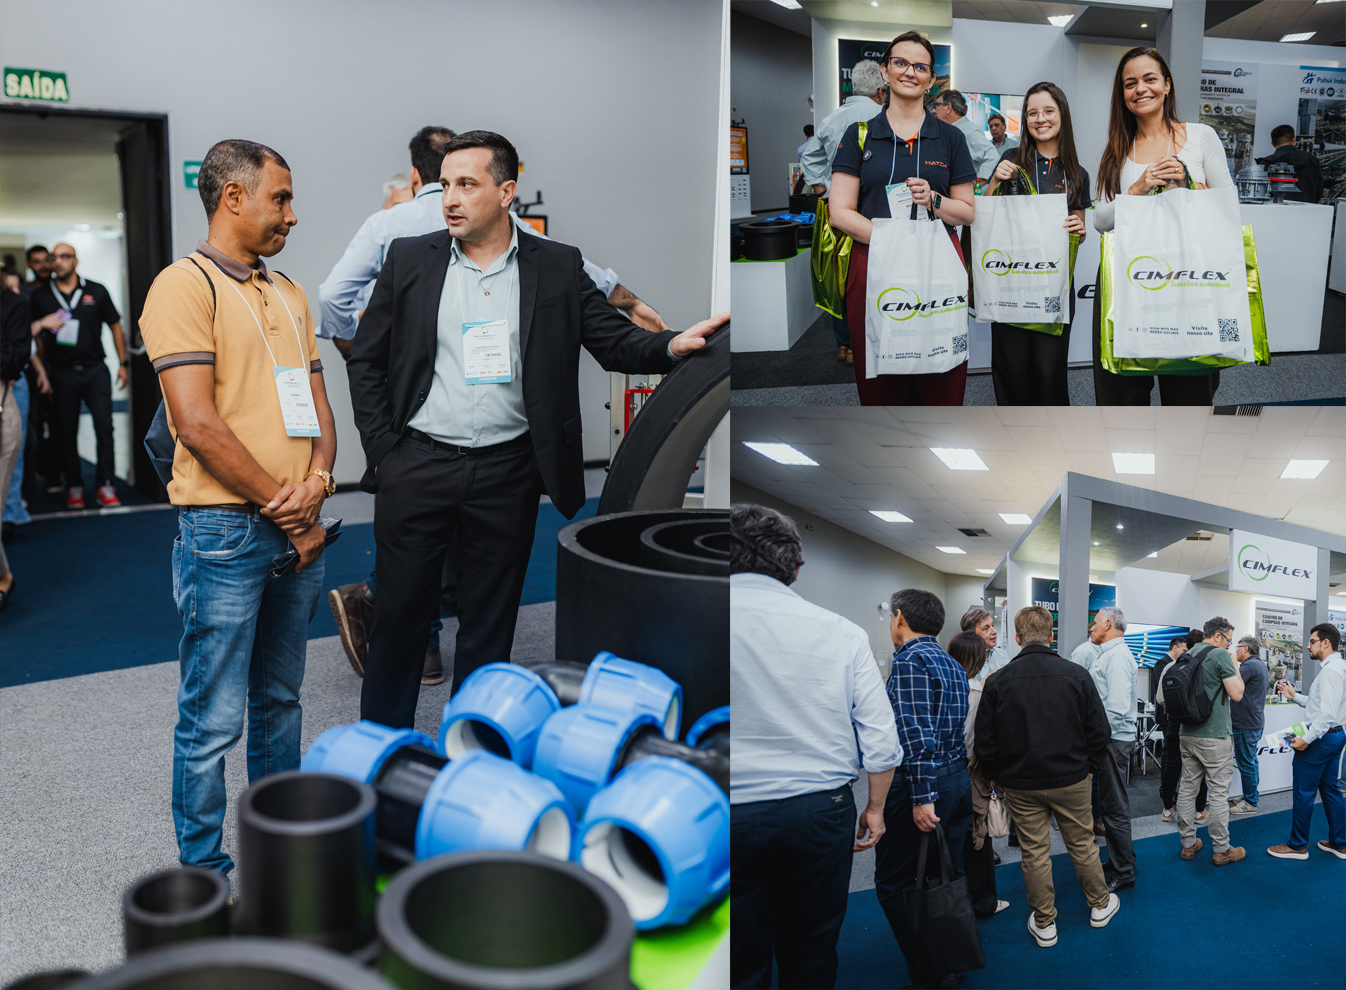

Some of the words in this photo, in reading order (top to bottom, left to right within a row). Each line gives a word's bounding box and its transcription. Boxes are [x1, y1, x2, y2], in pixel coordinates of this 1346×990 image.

[6, 71, 68, 99] SAÍDA
[925, 160, 948, 169] HATCH
[985, 260, 1060, 270] CIMFLEX
[1133, 270, 1230, 281] CIMFLEX
[882, 294, 968, 312] CIMFLEX
[1242, 560, 1312, 579] CIMFLEX
